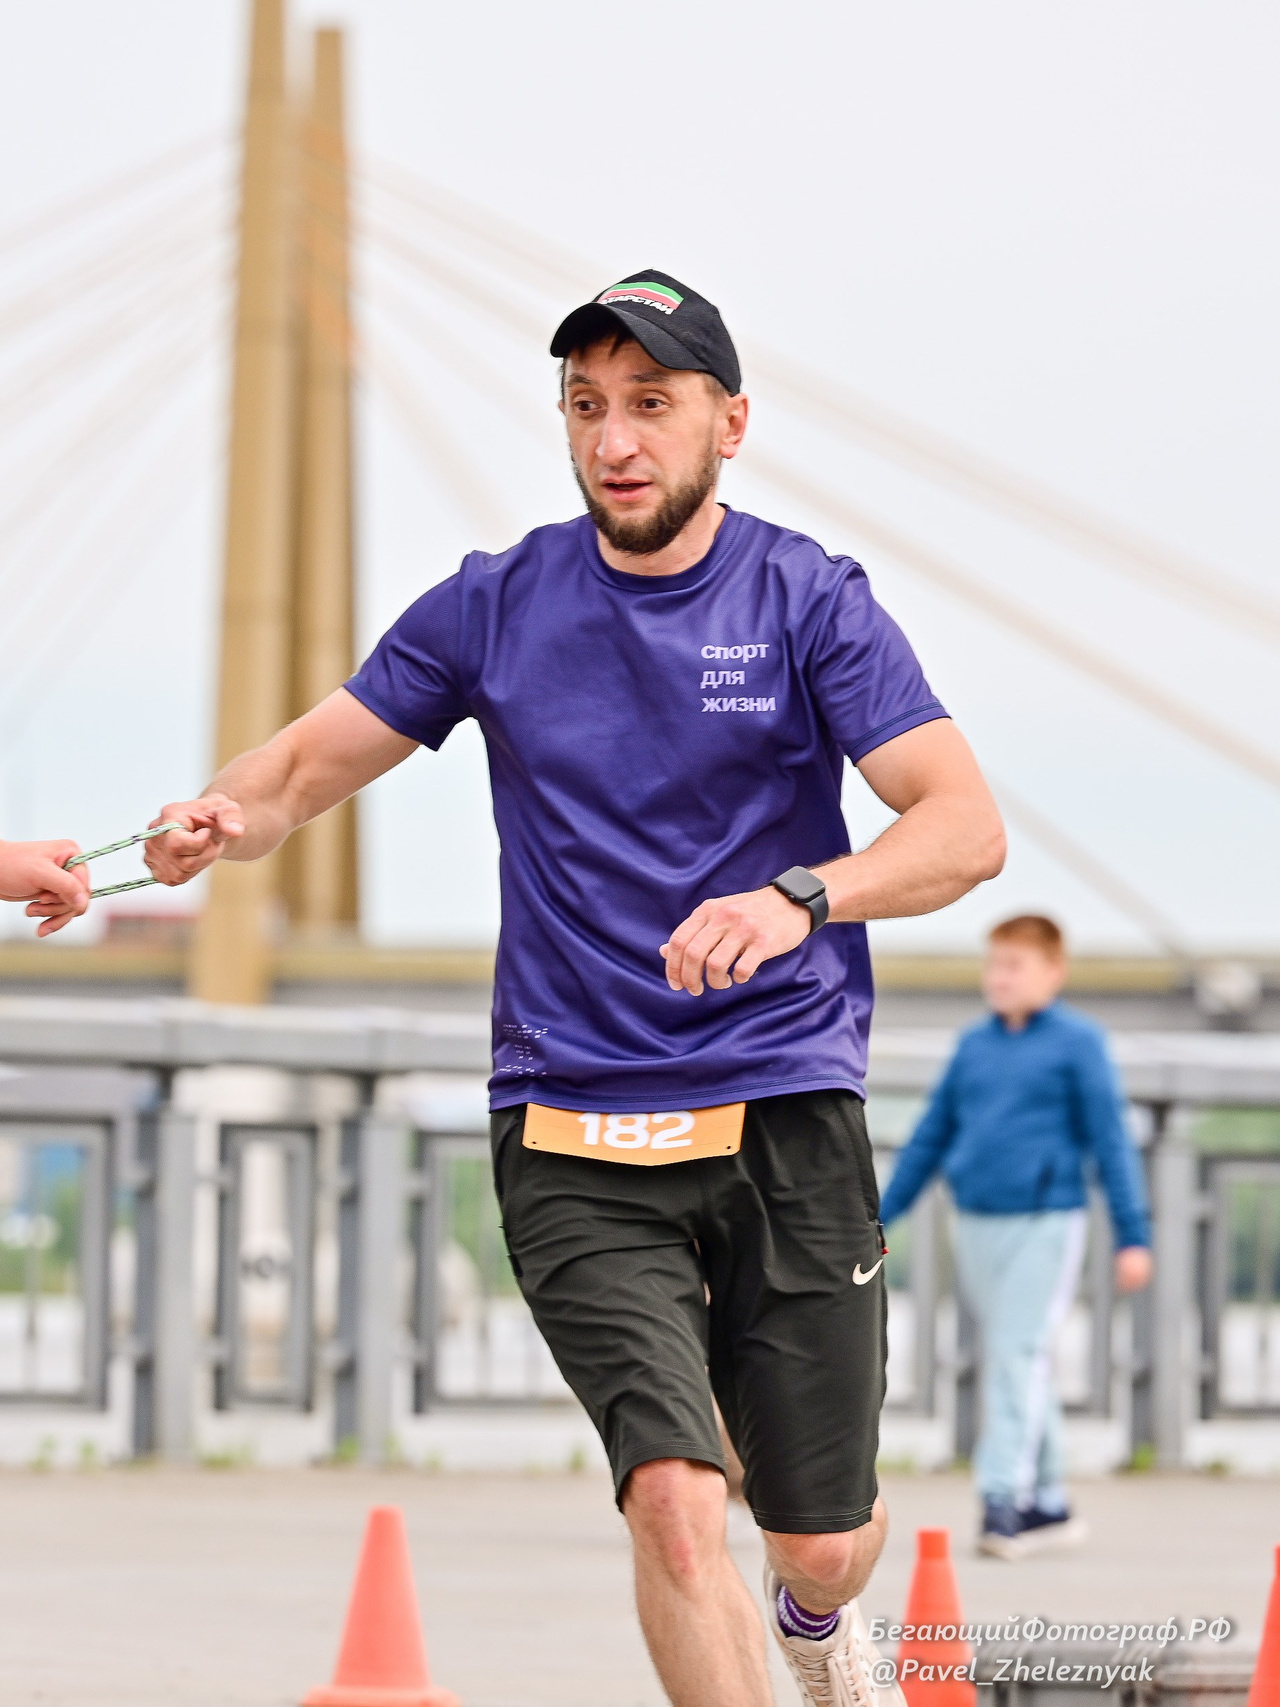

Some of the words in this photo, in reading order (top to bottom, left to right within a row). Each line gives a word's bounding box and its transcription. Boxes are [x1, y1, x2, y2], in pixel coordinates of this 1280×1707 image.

[700, 643, 770, 663] спорт
[700, 670, 746, 689] для
[701, 697, 776, 712] жизни
[577, 1110, 696, 1149] 182
